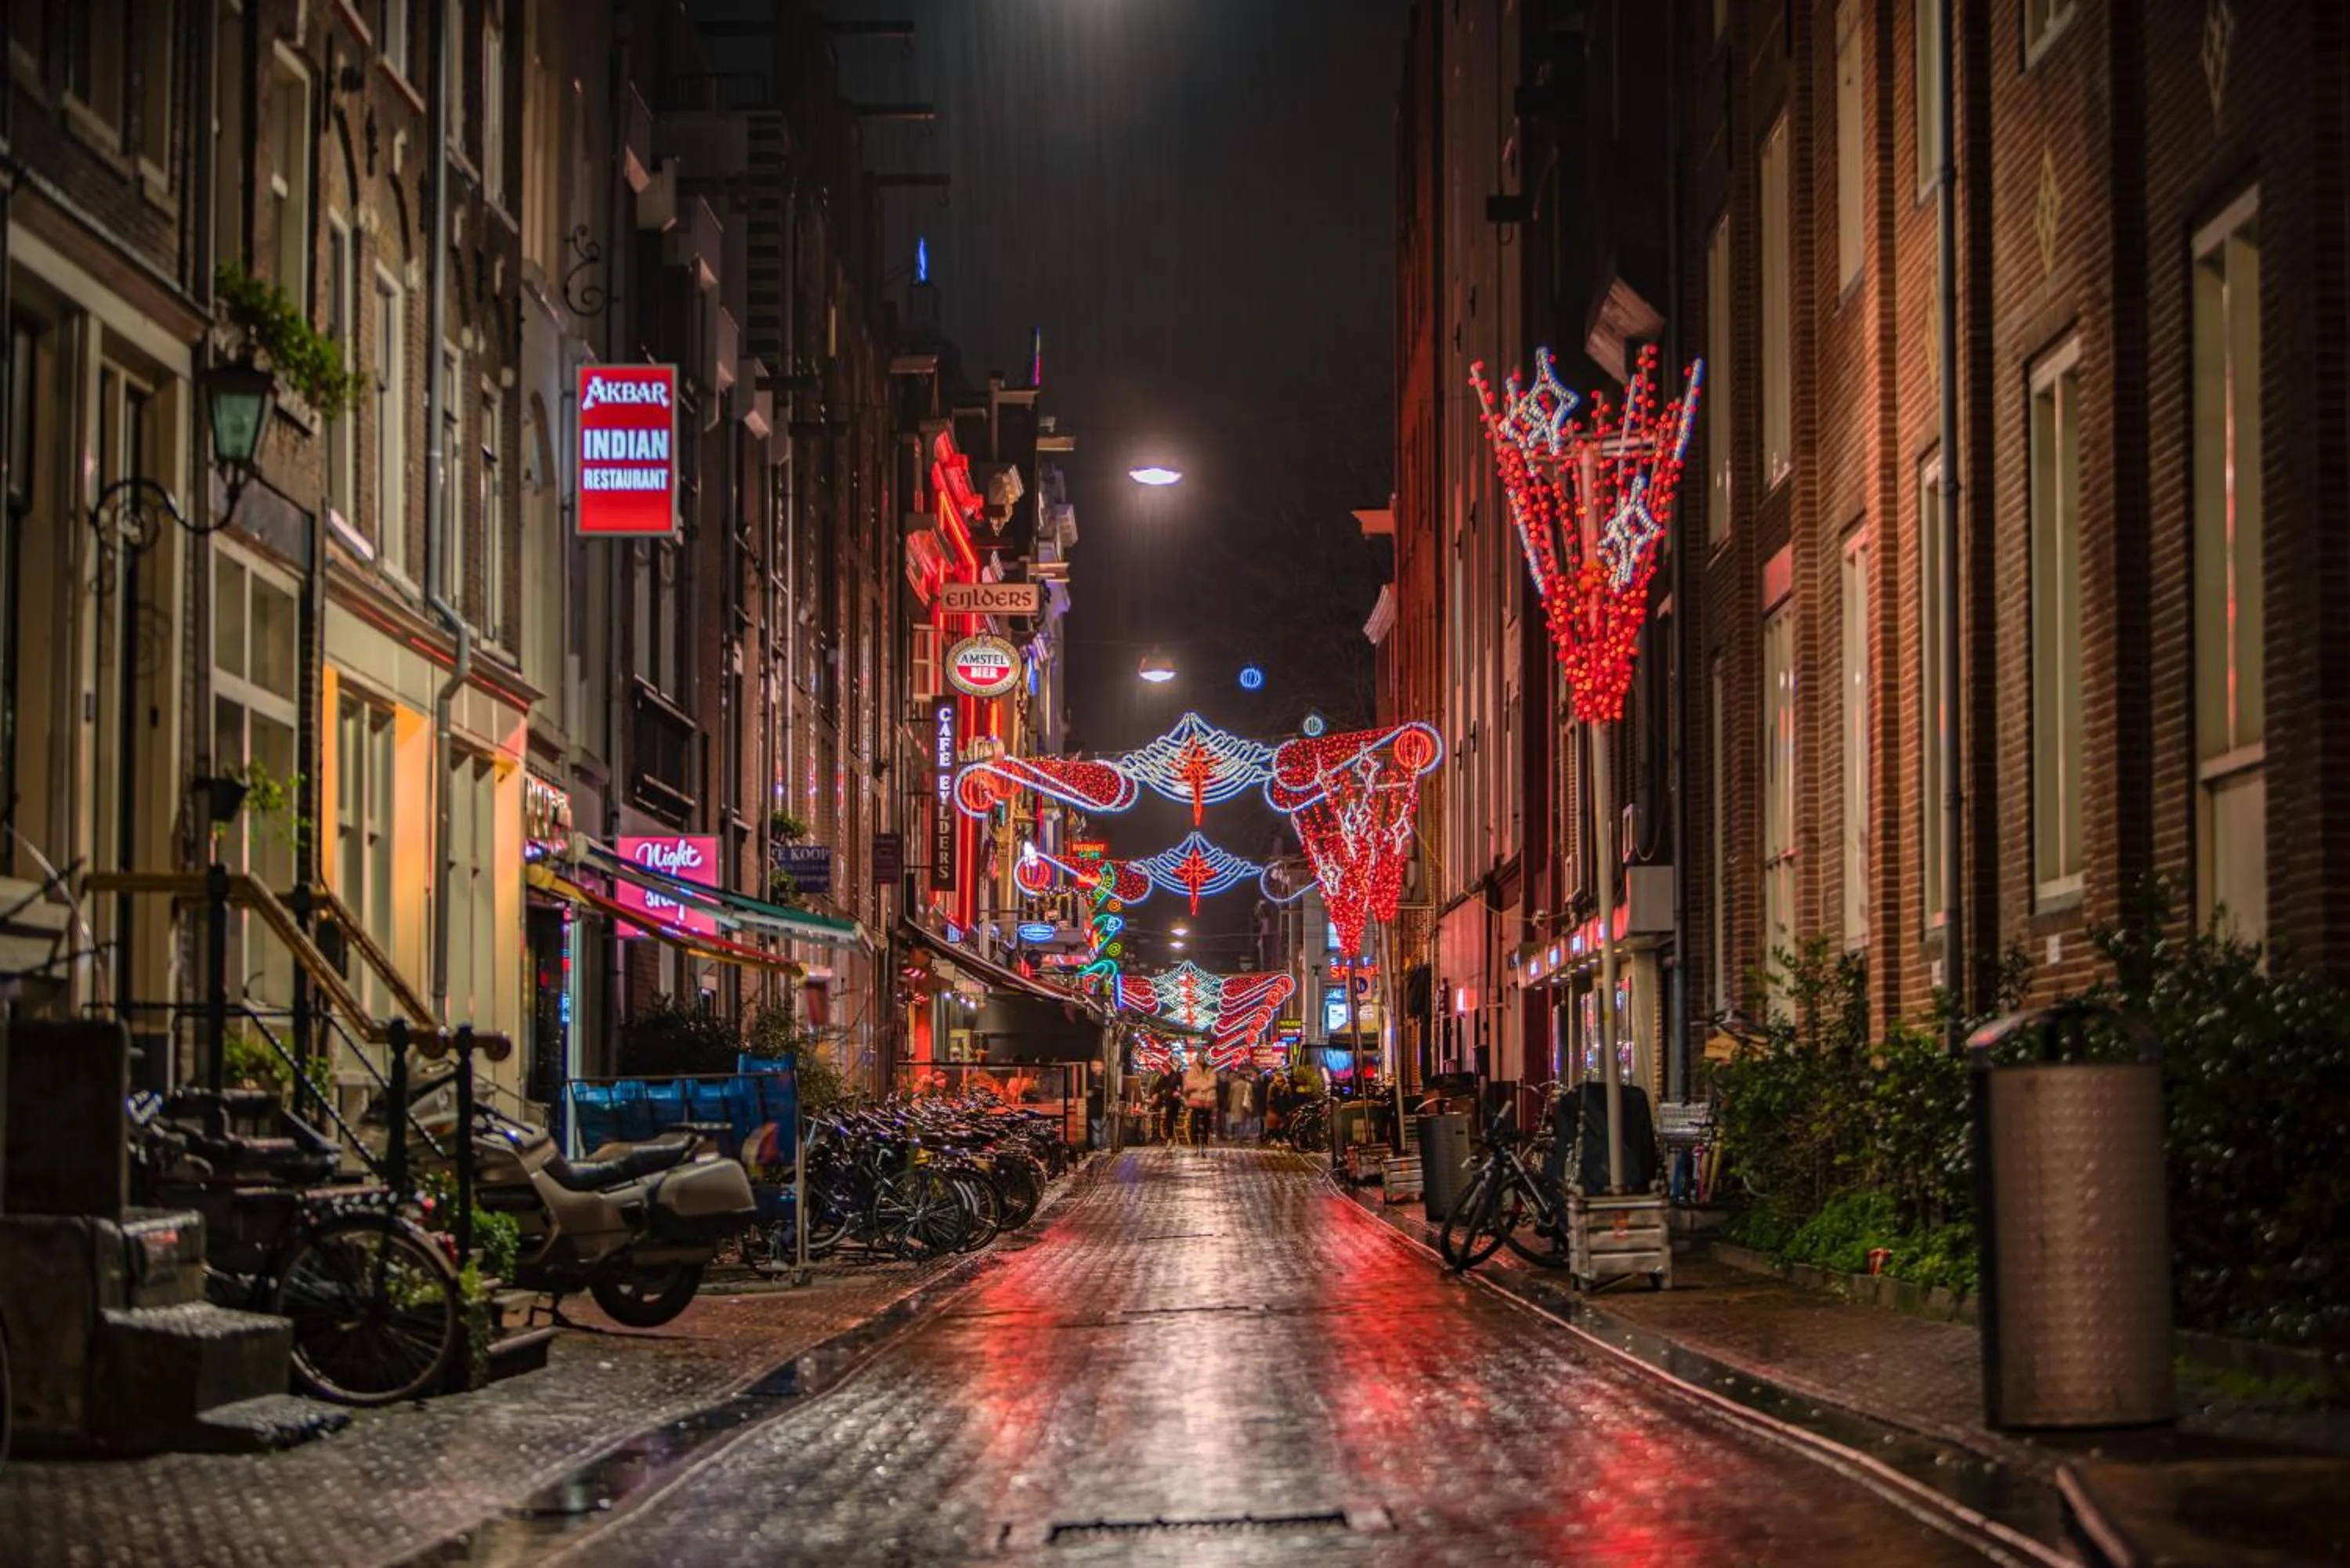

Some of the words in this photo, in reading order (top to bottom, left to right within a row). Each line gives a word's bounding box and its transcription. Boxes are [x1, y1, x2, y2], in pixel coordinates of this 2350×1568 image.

[582, 375, 671, 410] AKBAR
[583, 428, 669, 461] INDIAN
[583, 468, 668, 490] RESTAURANT
[960, 654, 1006, 665] AMSTEL
[971, 667, 999, 678] BIER
[938, 706, 953, 767] CAFE
[938, 775, 953, 880] EYLDERS
[635, 838, 703, 876] Night
